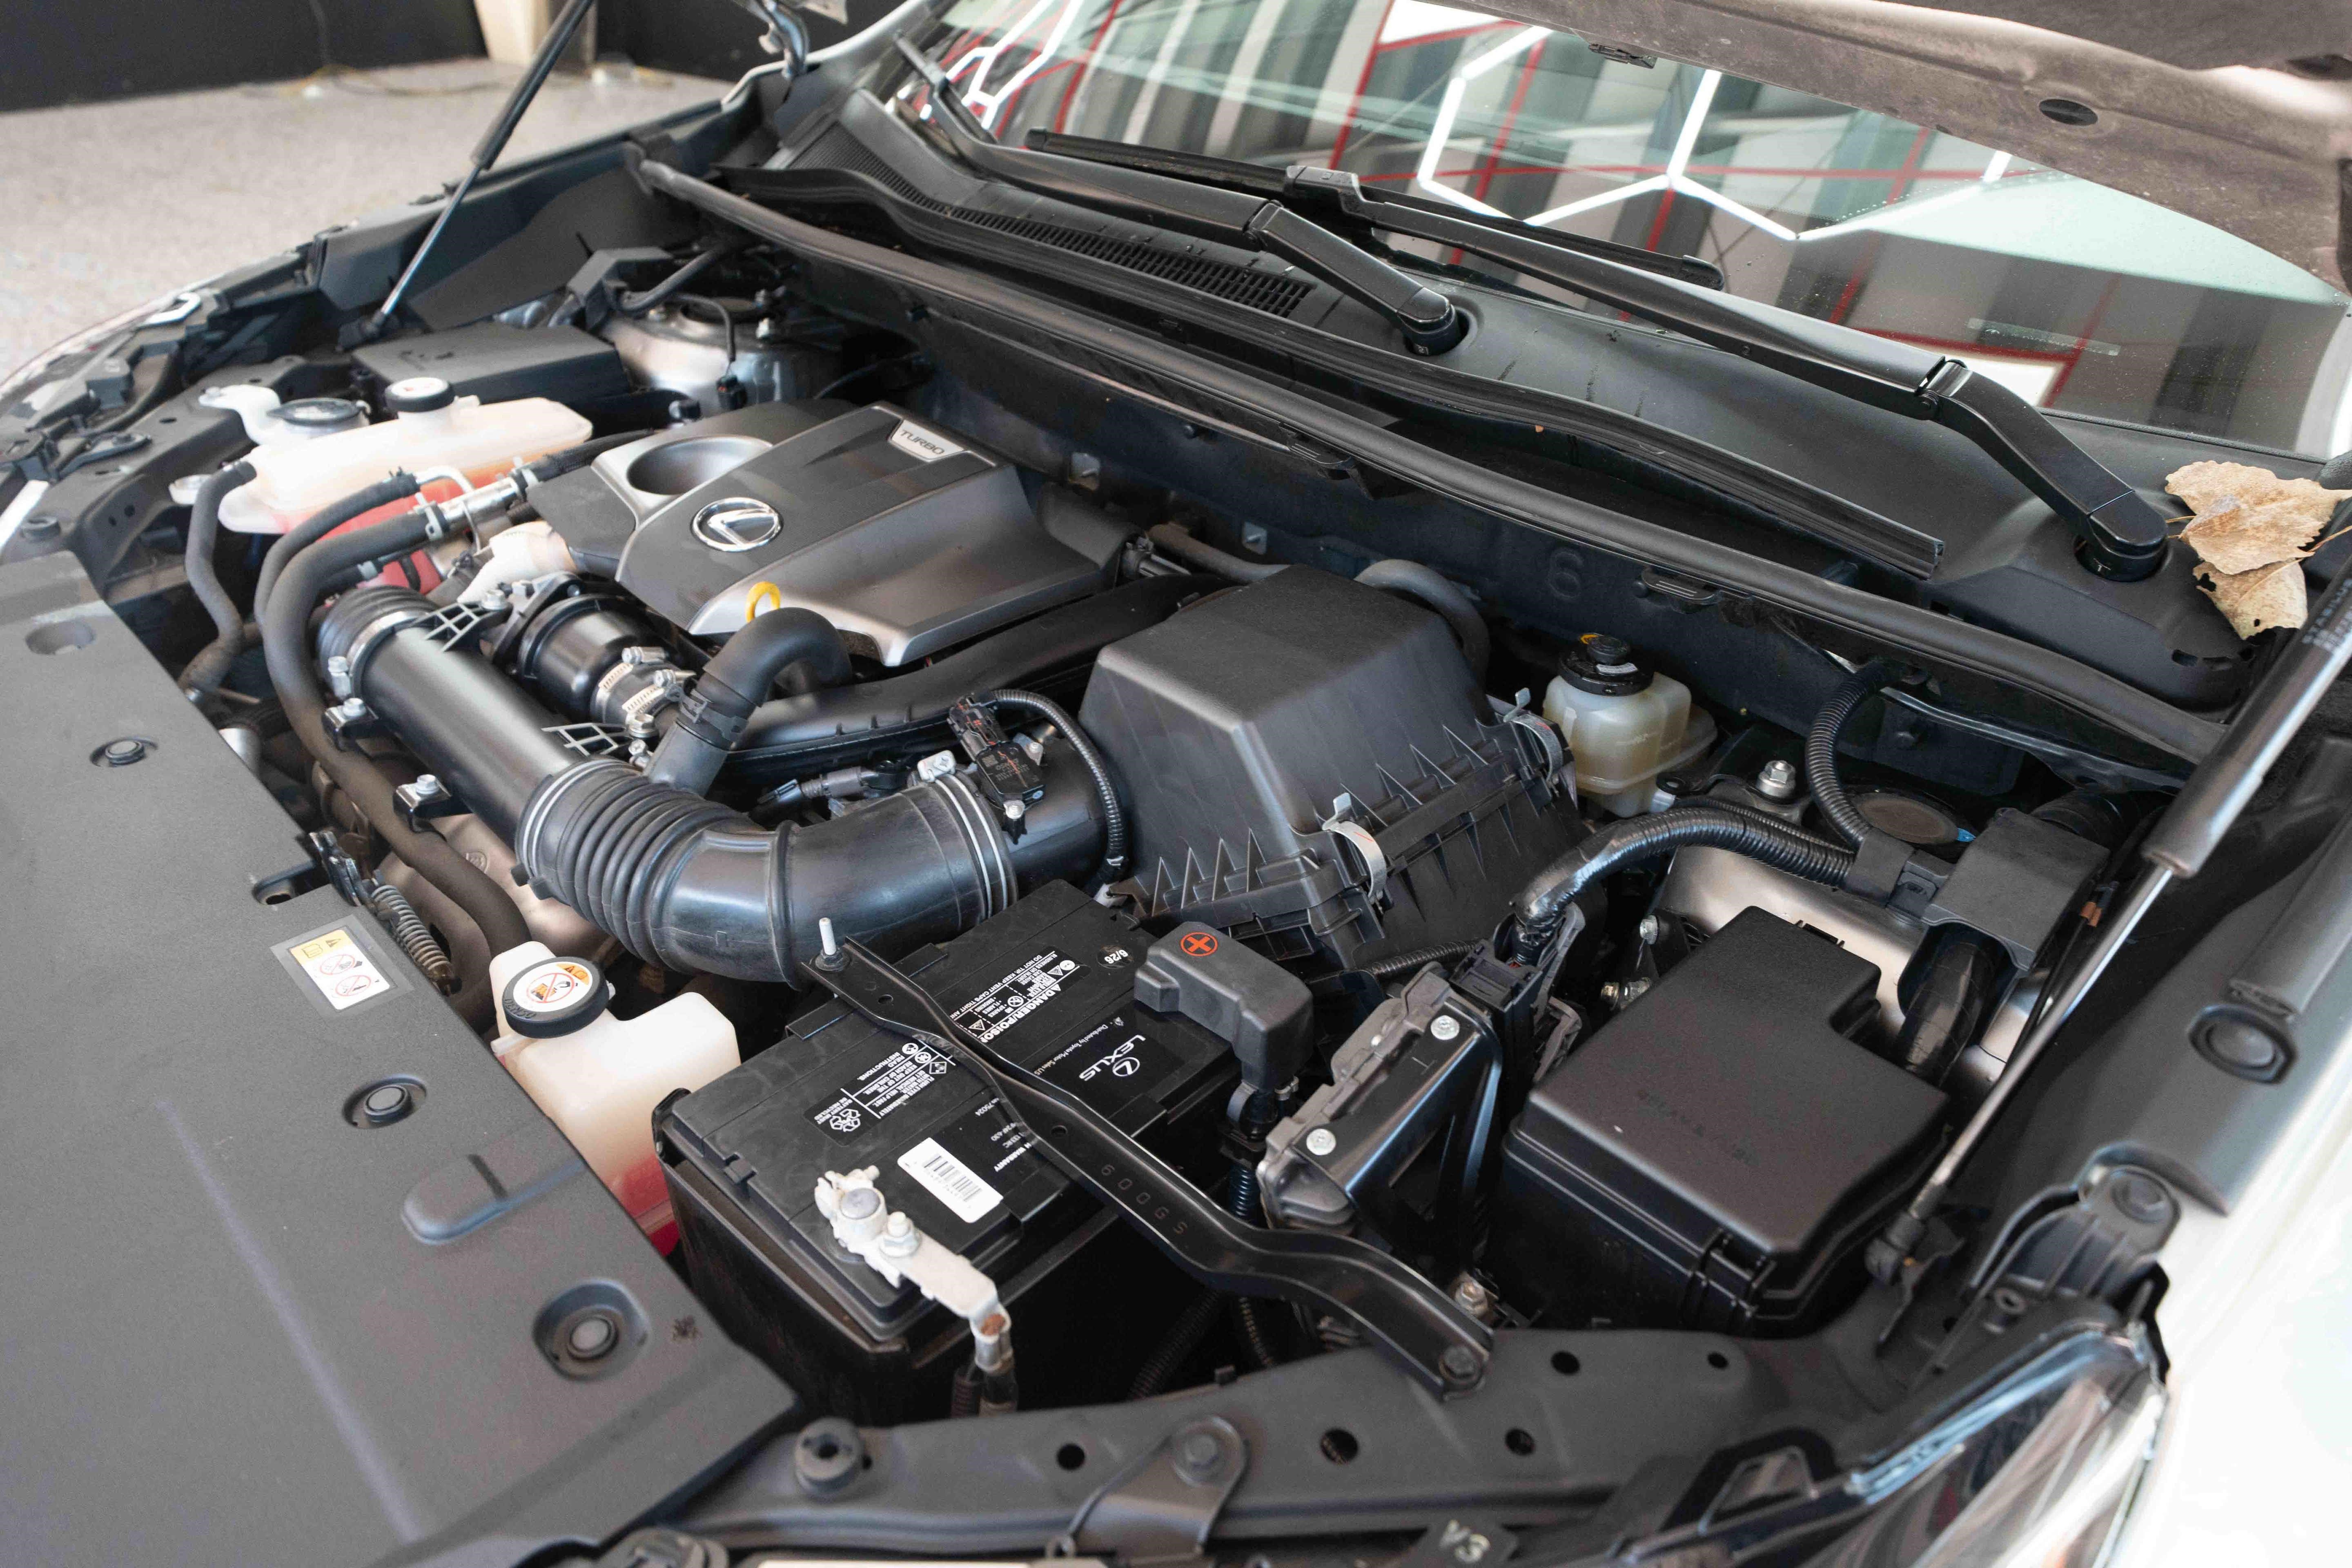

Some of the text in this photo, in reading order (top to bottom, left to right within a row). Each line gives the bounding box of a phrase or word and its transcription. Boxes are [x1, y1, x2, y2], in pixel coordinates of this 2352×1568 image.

[898, 428, 945, 457] TURBO
[1103, 948, 1129, 965] 6/26
[1013, 966, 1025, 974] TIP.
[1022, 960, 1035, 969] NOT
[1000, 972, 1016, 984] KEEP
[987, 981, 1003, 992] VENT
[973, 990, 990, 1002] CAPS
[958, 1000, 976, 1012] TIGHT
[1083, 1023, 1109, 1042] Distributed
[1065, 1041, 1082, 1054] Toyota
[886, 1055, 905, 1068] READ
[1052, 1051, 1069, 1062] Motor
[1077, 1032, 1146, 1082] LEXUS
[856, 1051, 900, 1082] INSTRUCTIONS.
[993, 1147, 1027, 1172] WARRANTY
